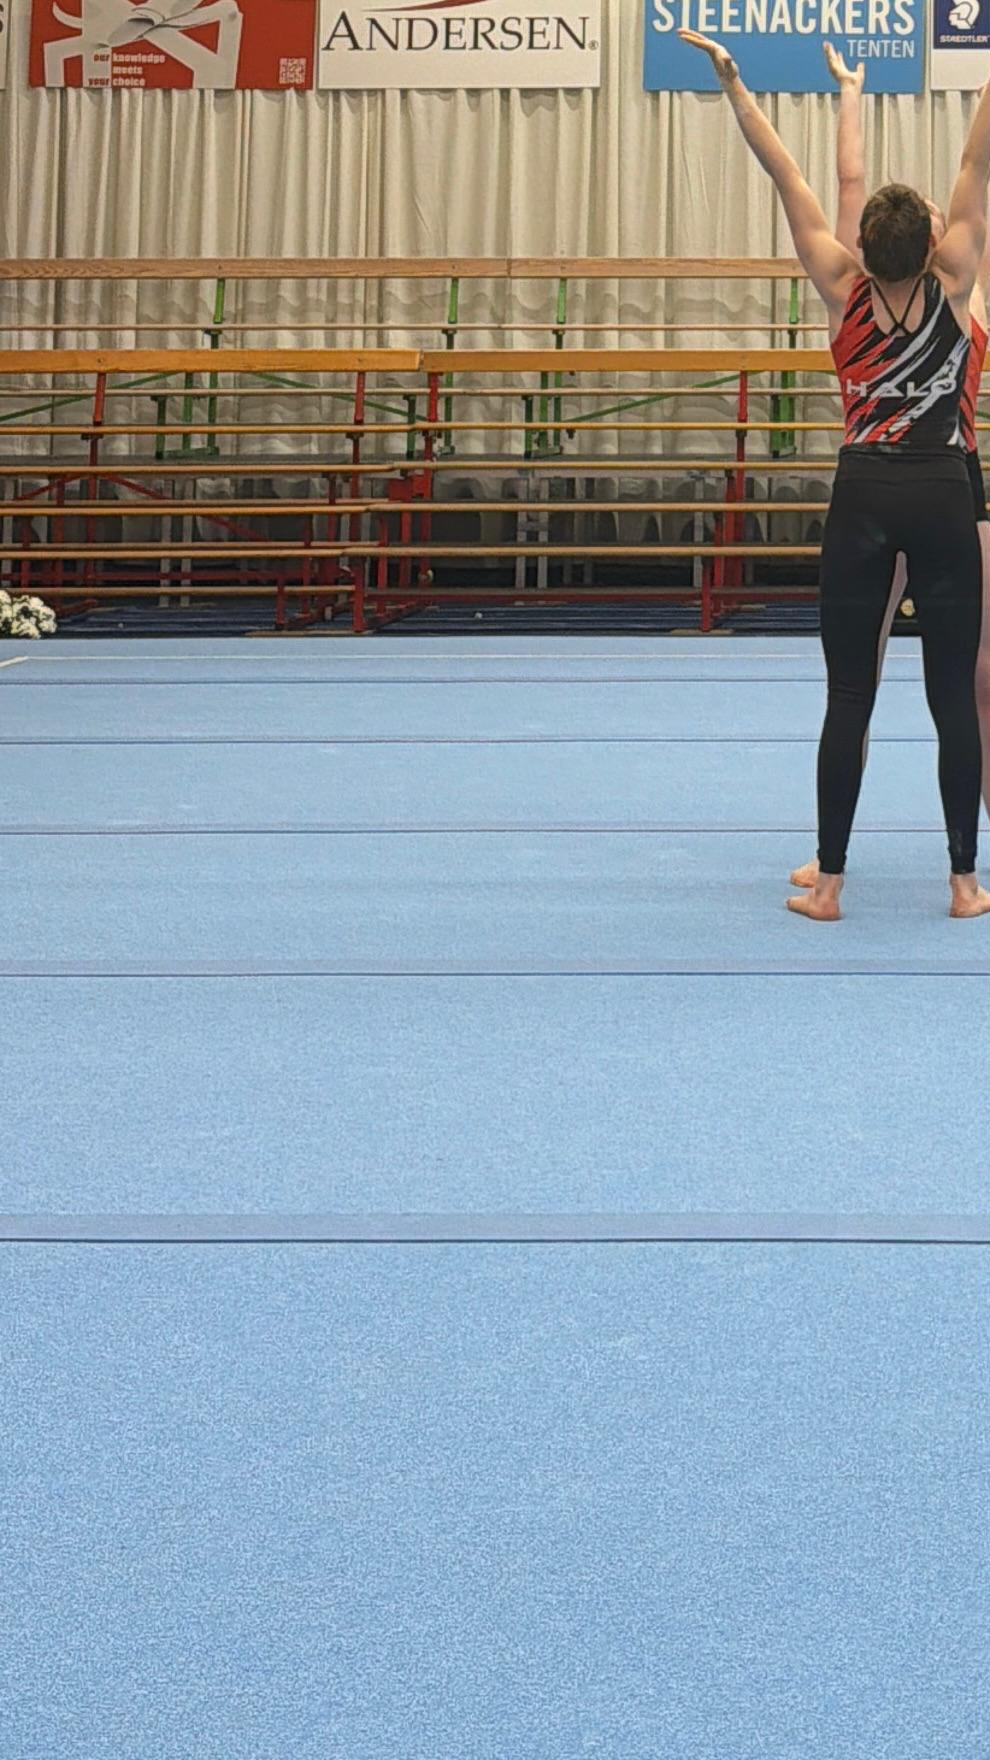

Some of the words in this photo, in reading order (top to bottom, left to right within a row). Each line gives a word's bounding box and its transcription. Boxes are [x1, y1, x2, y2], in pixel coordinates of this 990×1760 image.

[321, 10, 590, 51] ANDERSEN
[847, 39, 914, 58] TENTEN
[112, 53, 166, 64] knowledge
[112, 65, 143, 75] meets
[112, 76, 146, 87] choice
